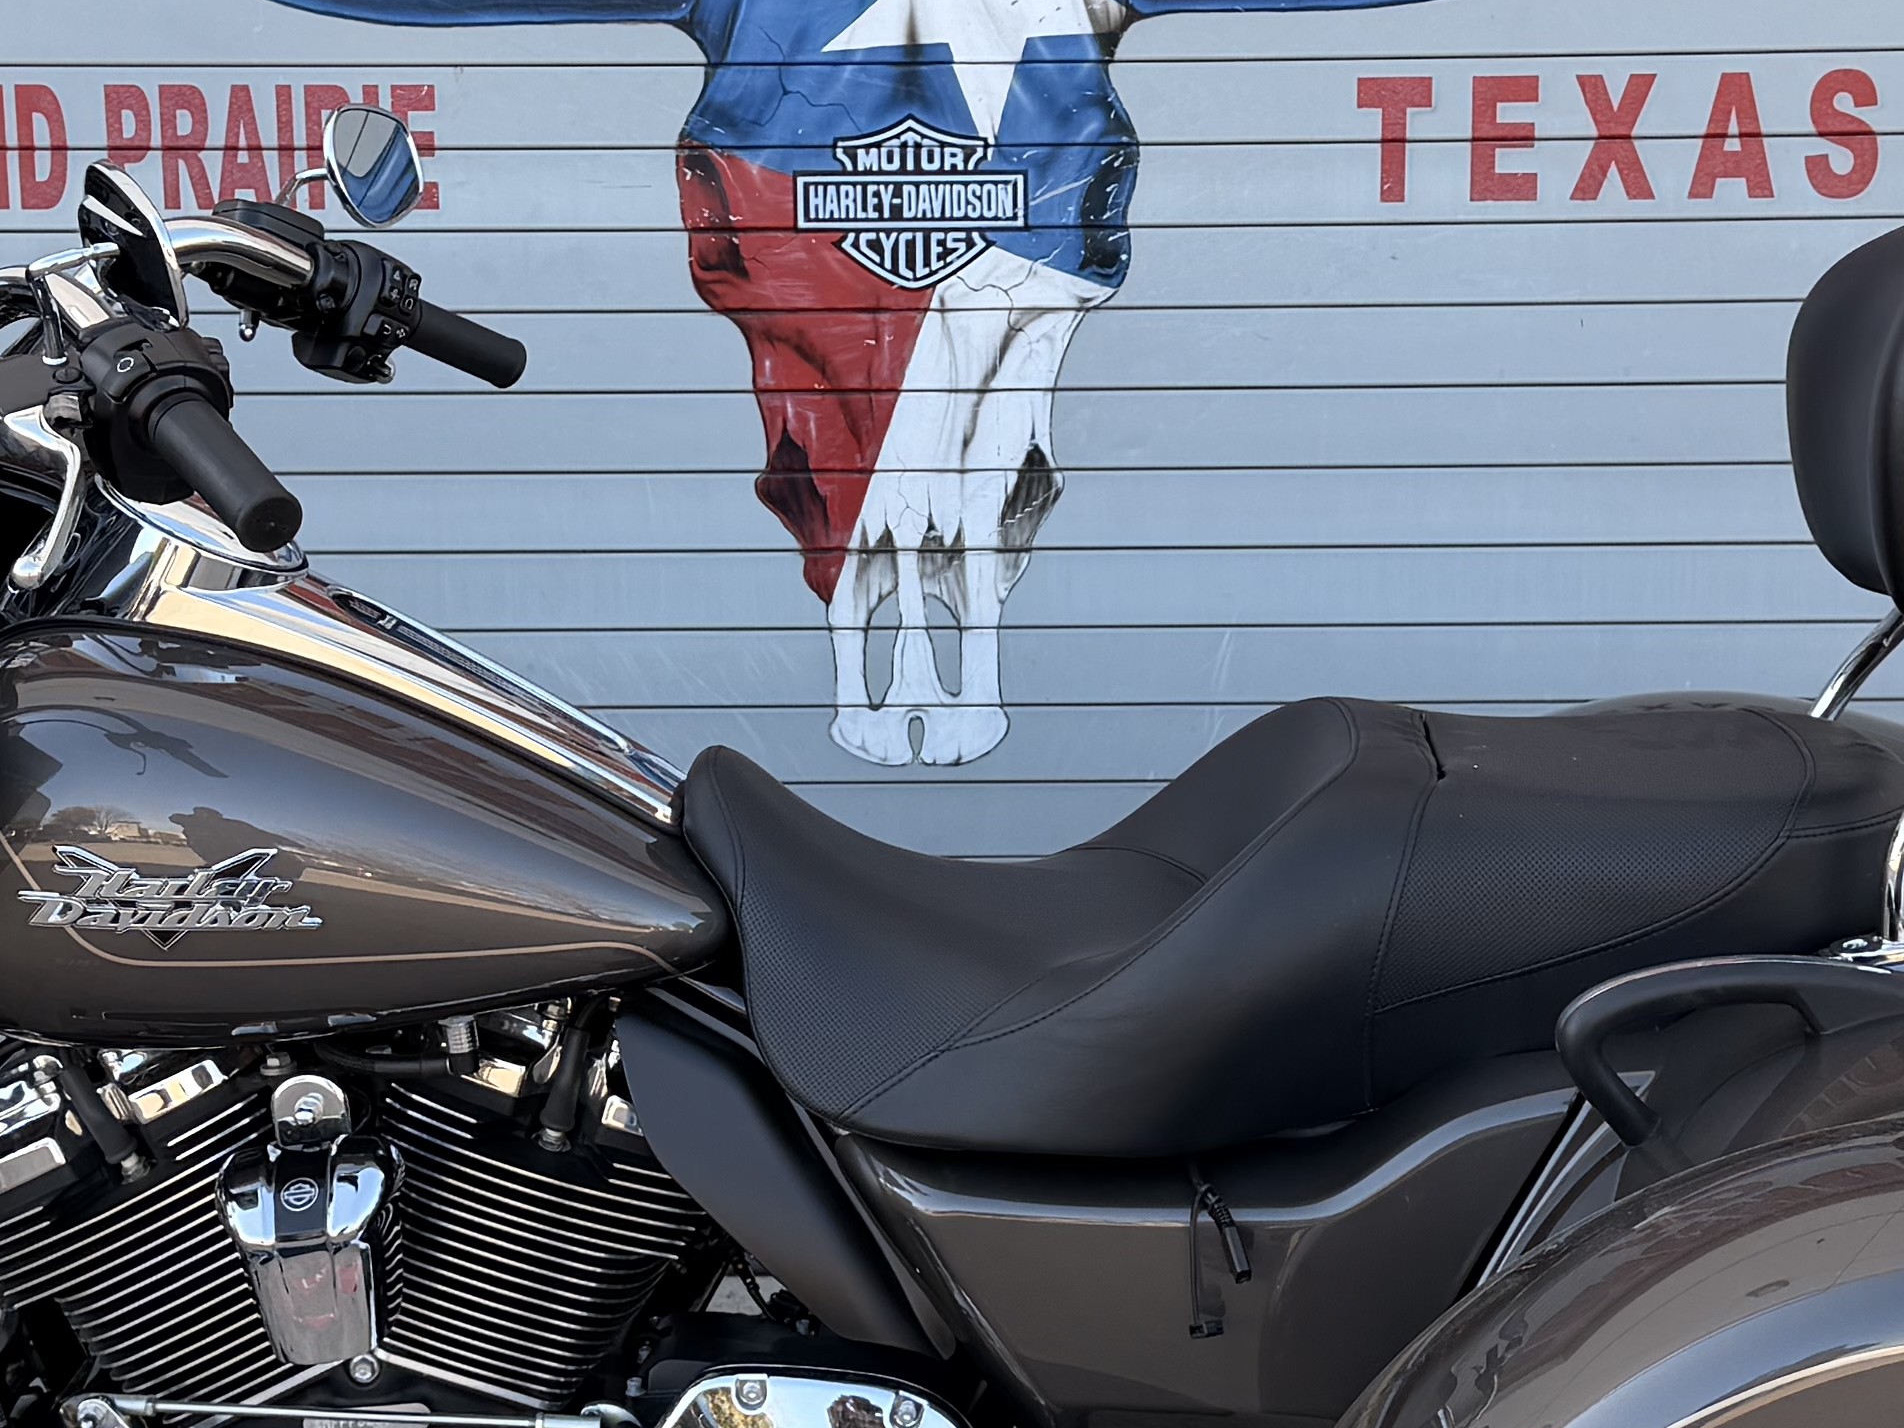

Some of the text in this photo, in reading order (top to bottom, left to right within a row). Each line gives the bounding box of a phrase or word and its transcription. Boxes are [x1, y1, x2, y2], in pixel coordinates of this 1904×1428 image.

[856, 130, 965, 172] MOTOR
[1356, 68, 1880, 203] TEXAS
[809, 183, 1014, 220] HARLEY-DAVIDSON
[858, 231, 967, 279] CYCLES
[53, 866, 293, 905] Harley
[18, 890, 324, 934] Davidson
